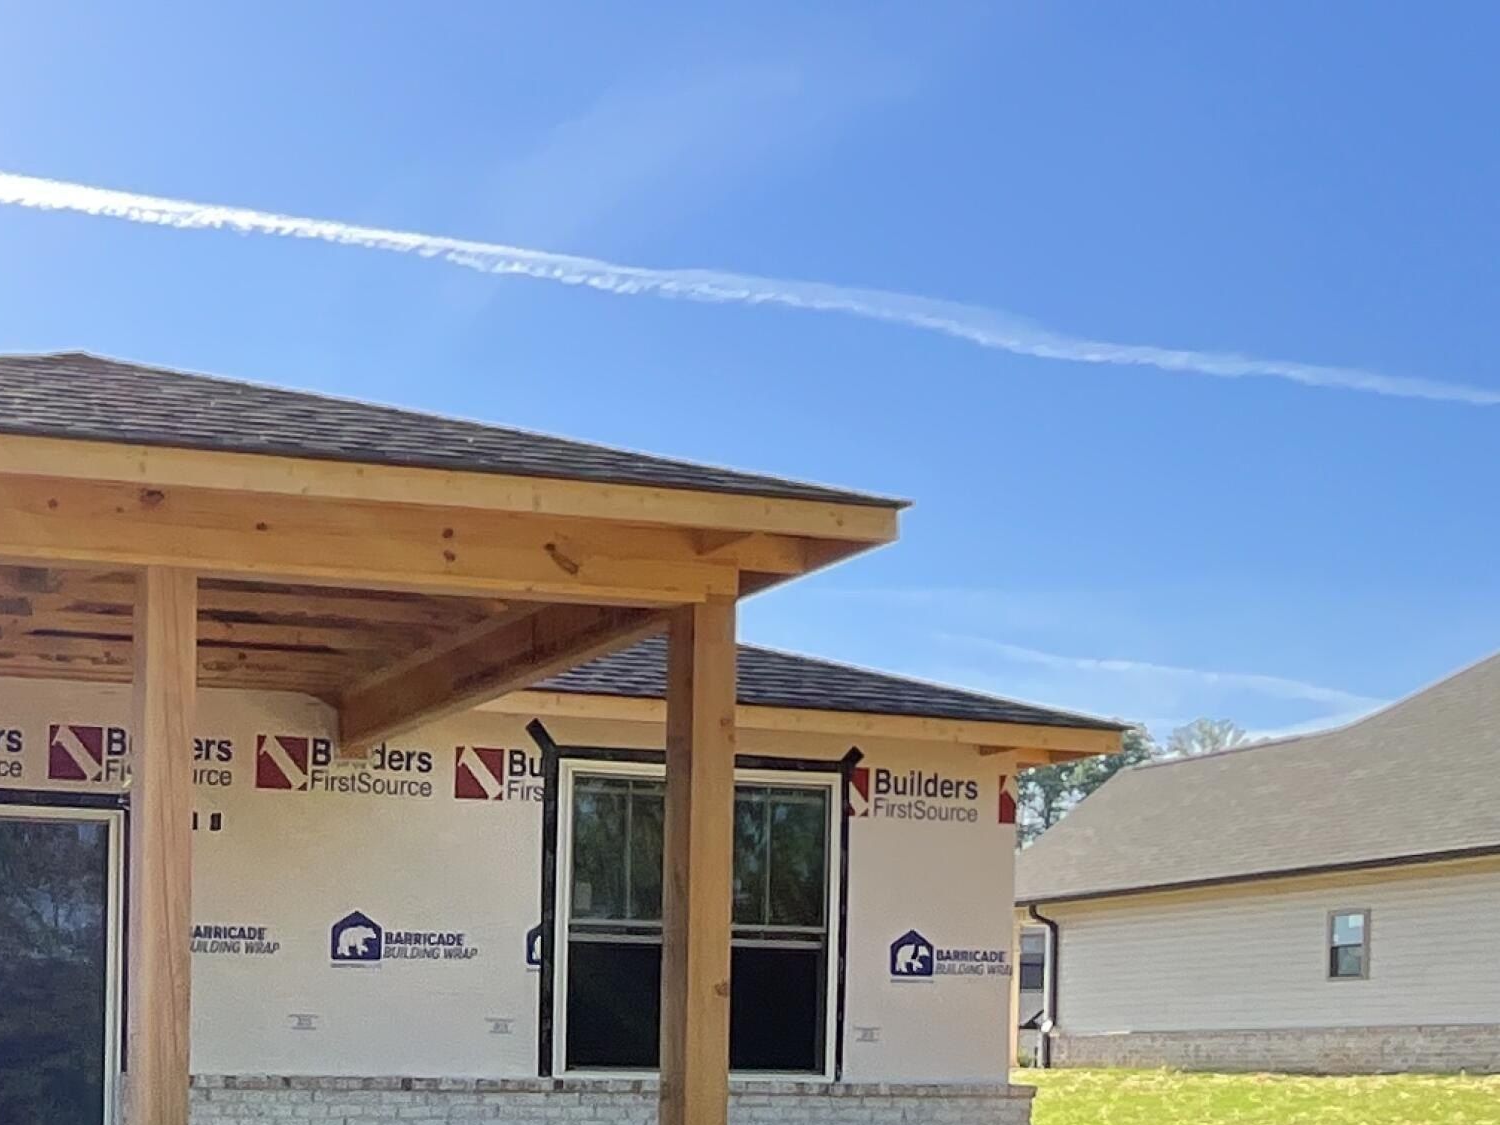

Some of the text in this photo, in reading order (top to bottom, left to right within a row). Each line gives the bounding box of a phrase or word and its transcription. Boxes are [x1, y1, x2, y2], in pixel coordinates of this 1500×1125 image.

[310, 769, 433, 798] FirstSource
[875, 768, 978, 800] Builders
[873, 797, 978, 823] FirstSource
[384, 931, 465, 946] BARRICADE
[383, 946, 440, 960] BUILDING
[936, 949, 1006, 963] BARRICADE
